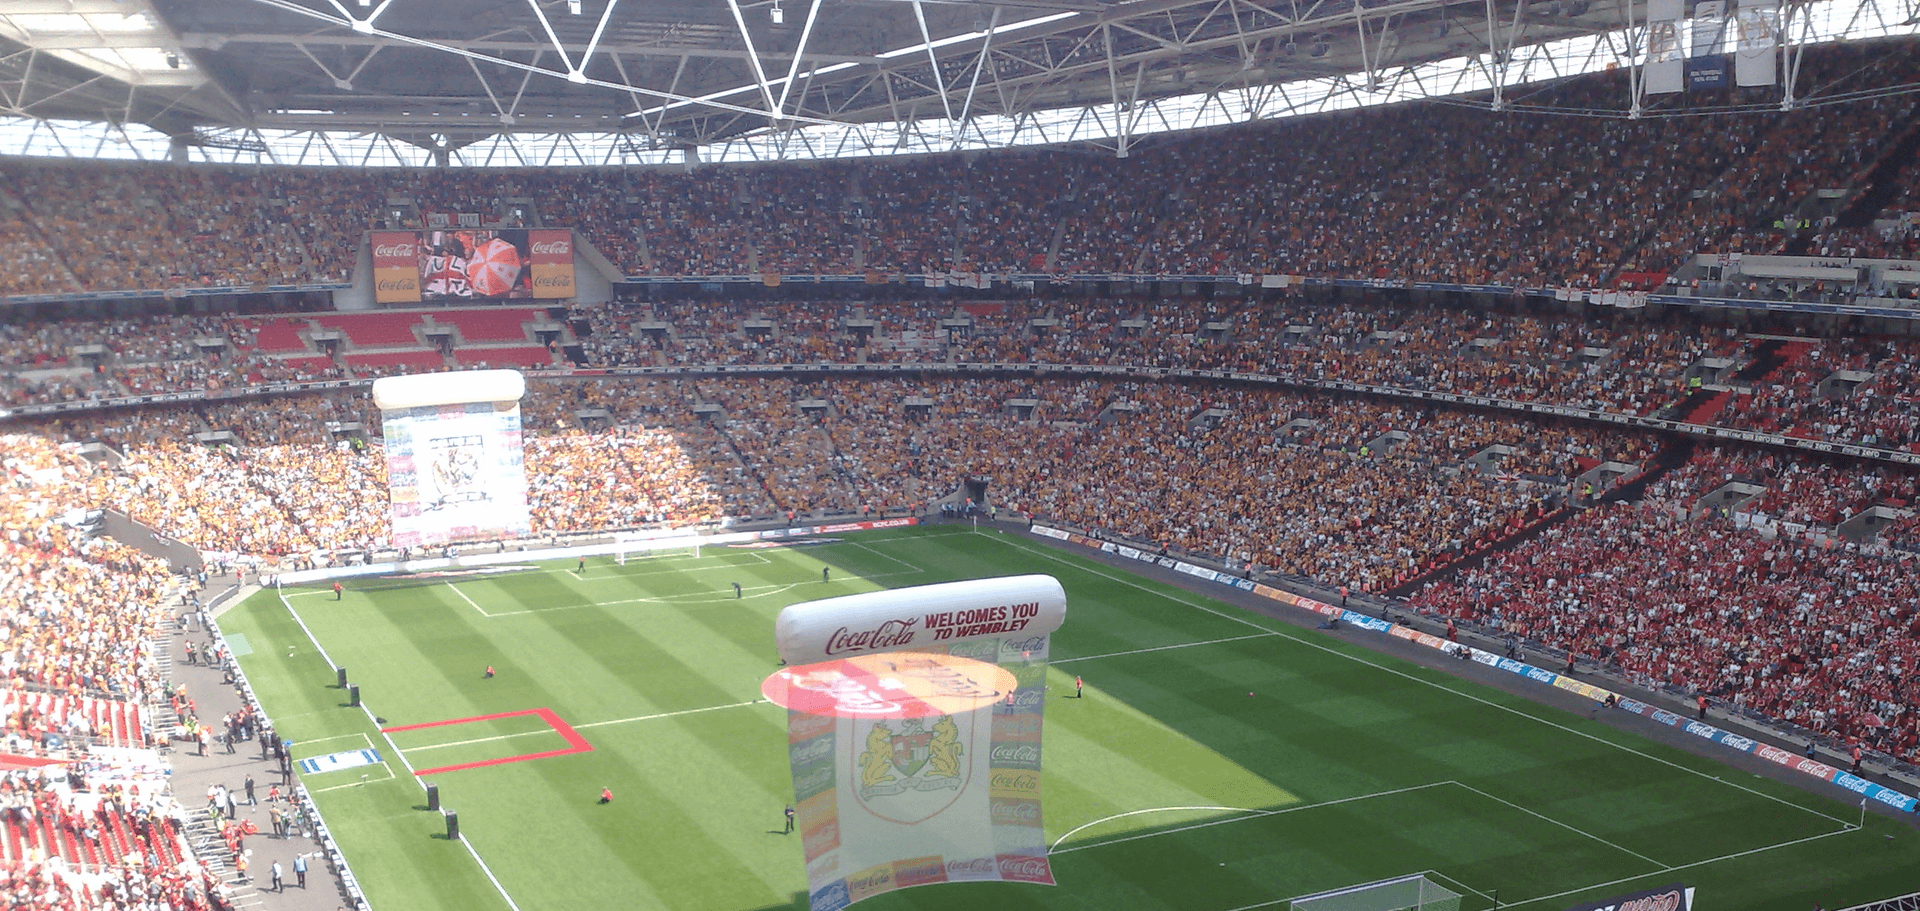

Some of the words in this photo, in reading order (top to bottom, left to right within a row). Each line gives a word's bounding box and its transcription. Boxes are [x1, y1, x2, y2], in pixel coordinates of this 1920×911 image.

[374, 243, 415, 257] Coca-Cola
[531, 241, 570, 254] Coca-Cola
[826, 617, 919, 655] Coca-Cola
[925, 606, 1006, 630] WELCOMES
[1011, 602, 1039, 619] YOU
[933, 628, 953, 640] TO
[955, 618, 1030, 638] WEMBLEY
[991, 745, 1039, 761] Coca-Cola
[1001, 859, 1046, 875] Coca-Cola
